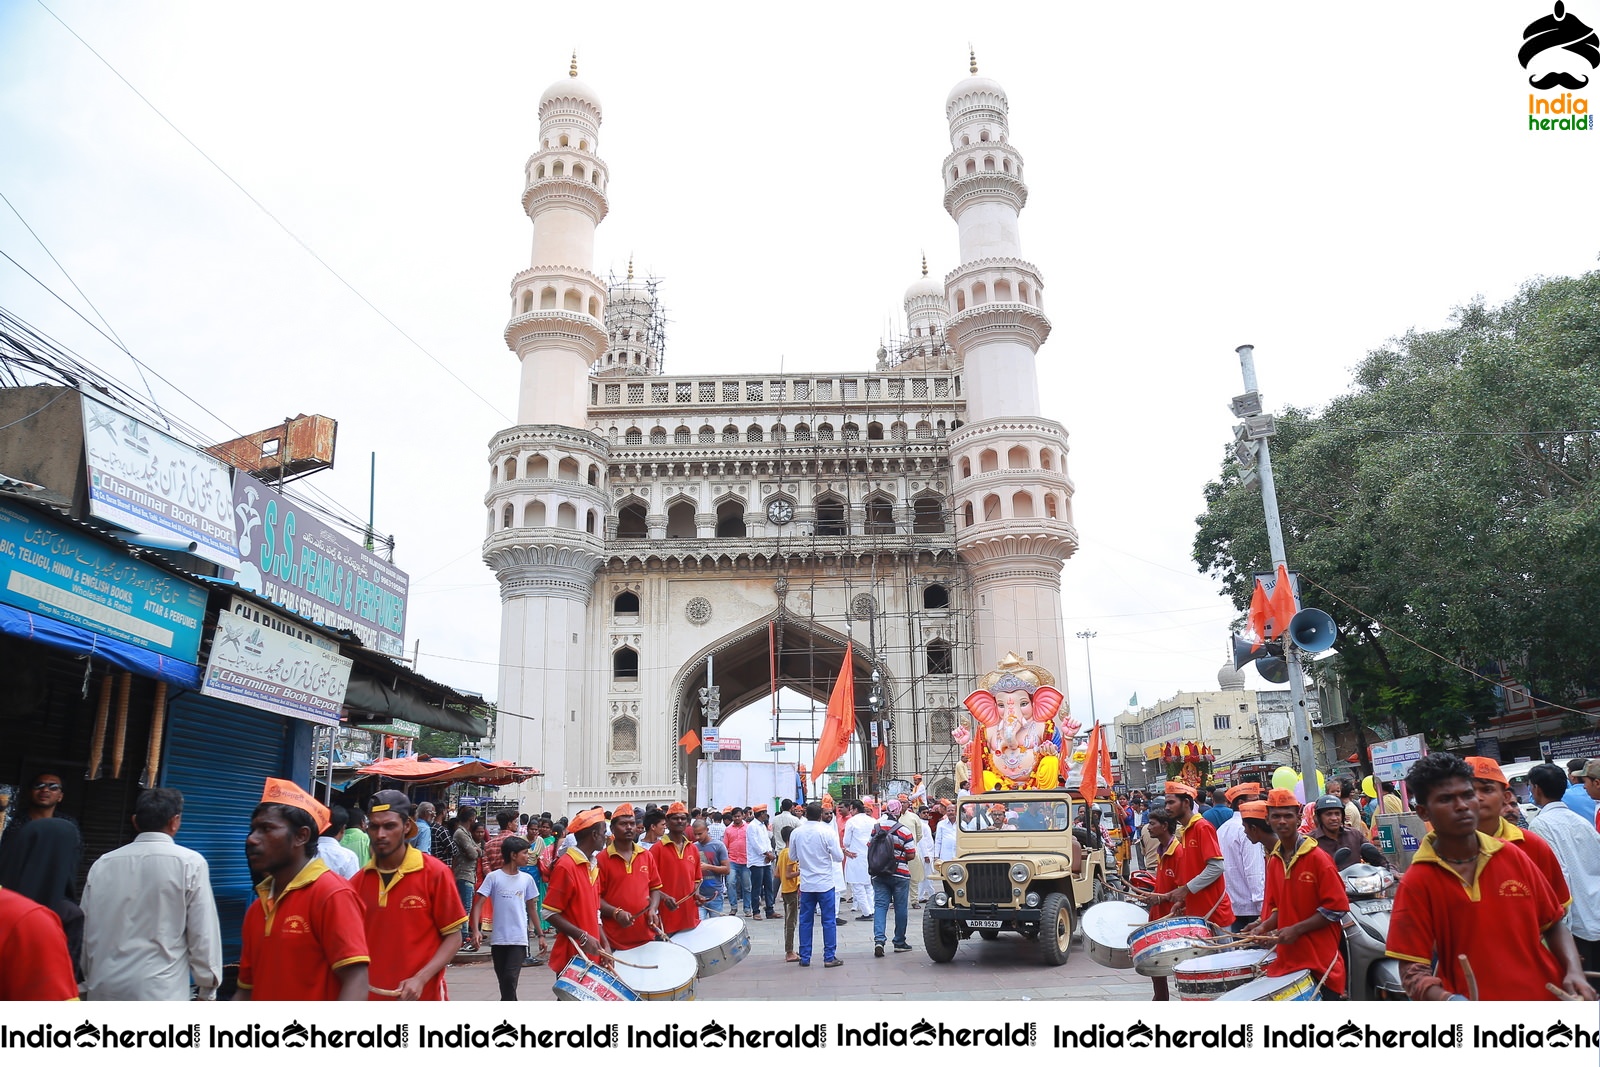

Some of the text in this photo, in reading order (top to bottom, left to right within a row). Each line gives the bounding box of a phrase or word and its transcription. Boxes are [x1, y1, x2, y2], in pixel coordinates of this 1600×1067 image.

[101, 474, 231, 542] Charminar Book Depot
[0, 538, 15, 559] BIC,
[18, 545, 50, 573] TELUGU,
[51, 559, 72, 579] HINDI
[73, 568, 79, 582] &
[80, 572, 109, 594] ENGLISH
[260, 500, 298, 585] S.S.
[300, 545, 343, 606] PEARLS
[345, 570, 353, 610] &
[354, 576, 403, 634] PERFUMES
[72, 583, 131, 614] Wholesale & Retail
[143, 598, 197, 629] ATTAR & PERFUMES
[220, 670, 281, 694] Charminar
[282, 688, 308, 703] Book
[309, 698, 337, 712] Depot
[1401, 837, 1416, 845] STE
